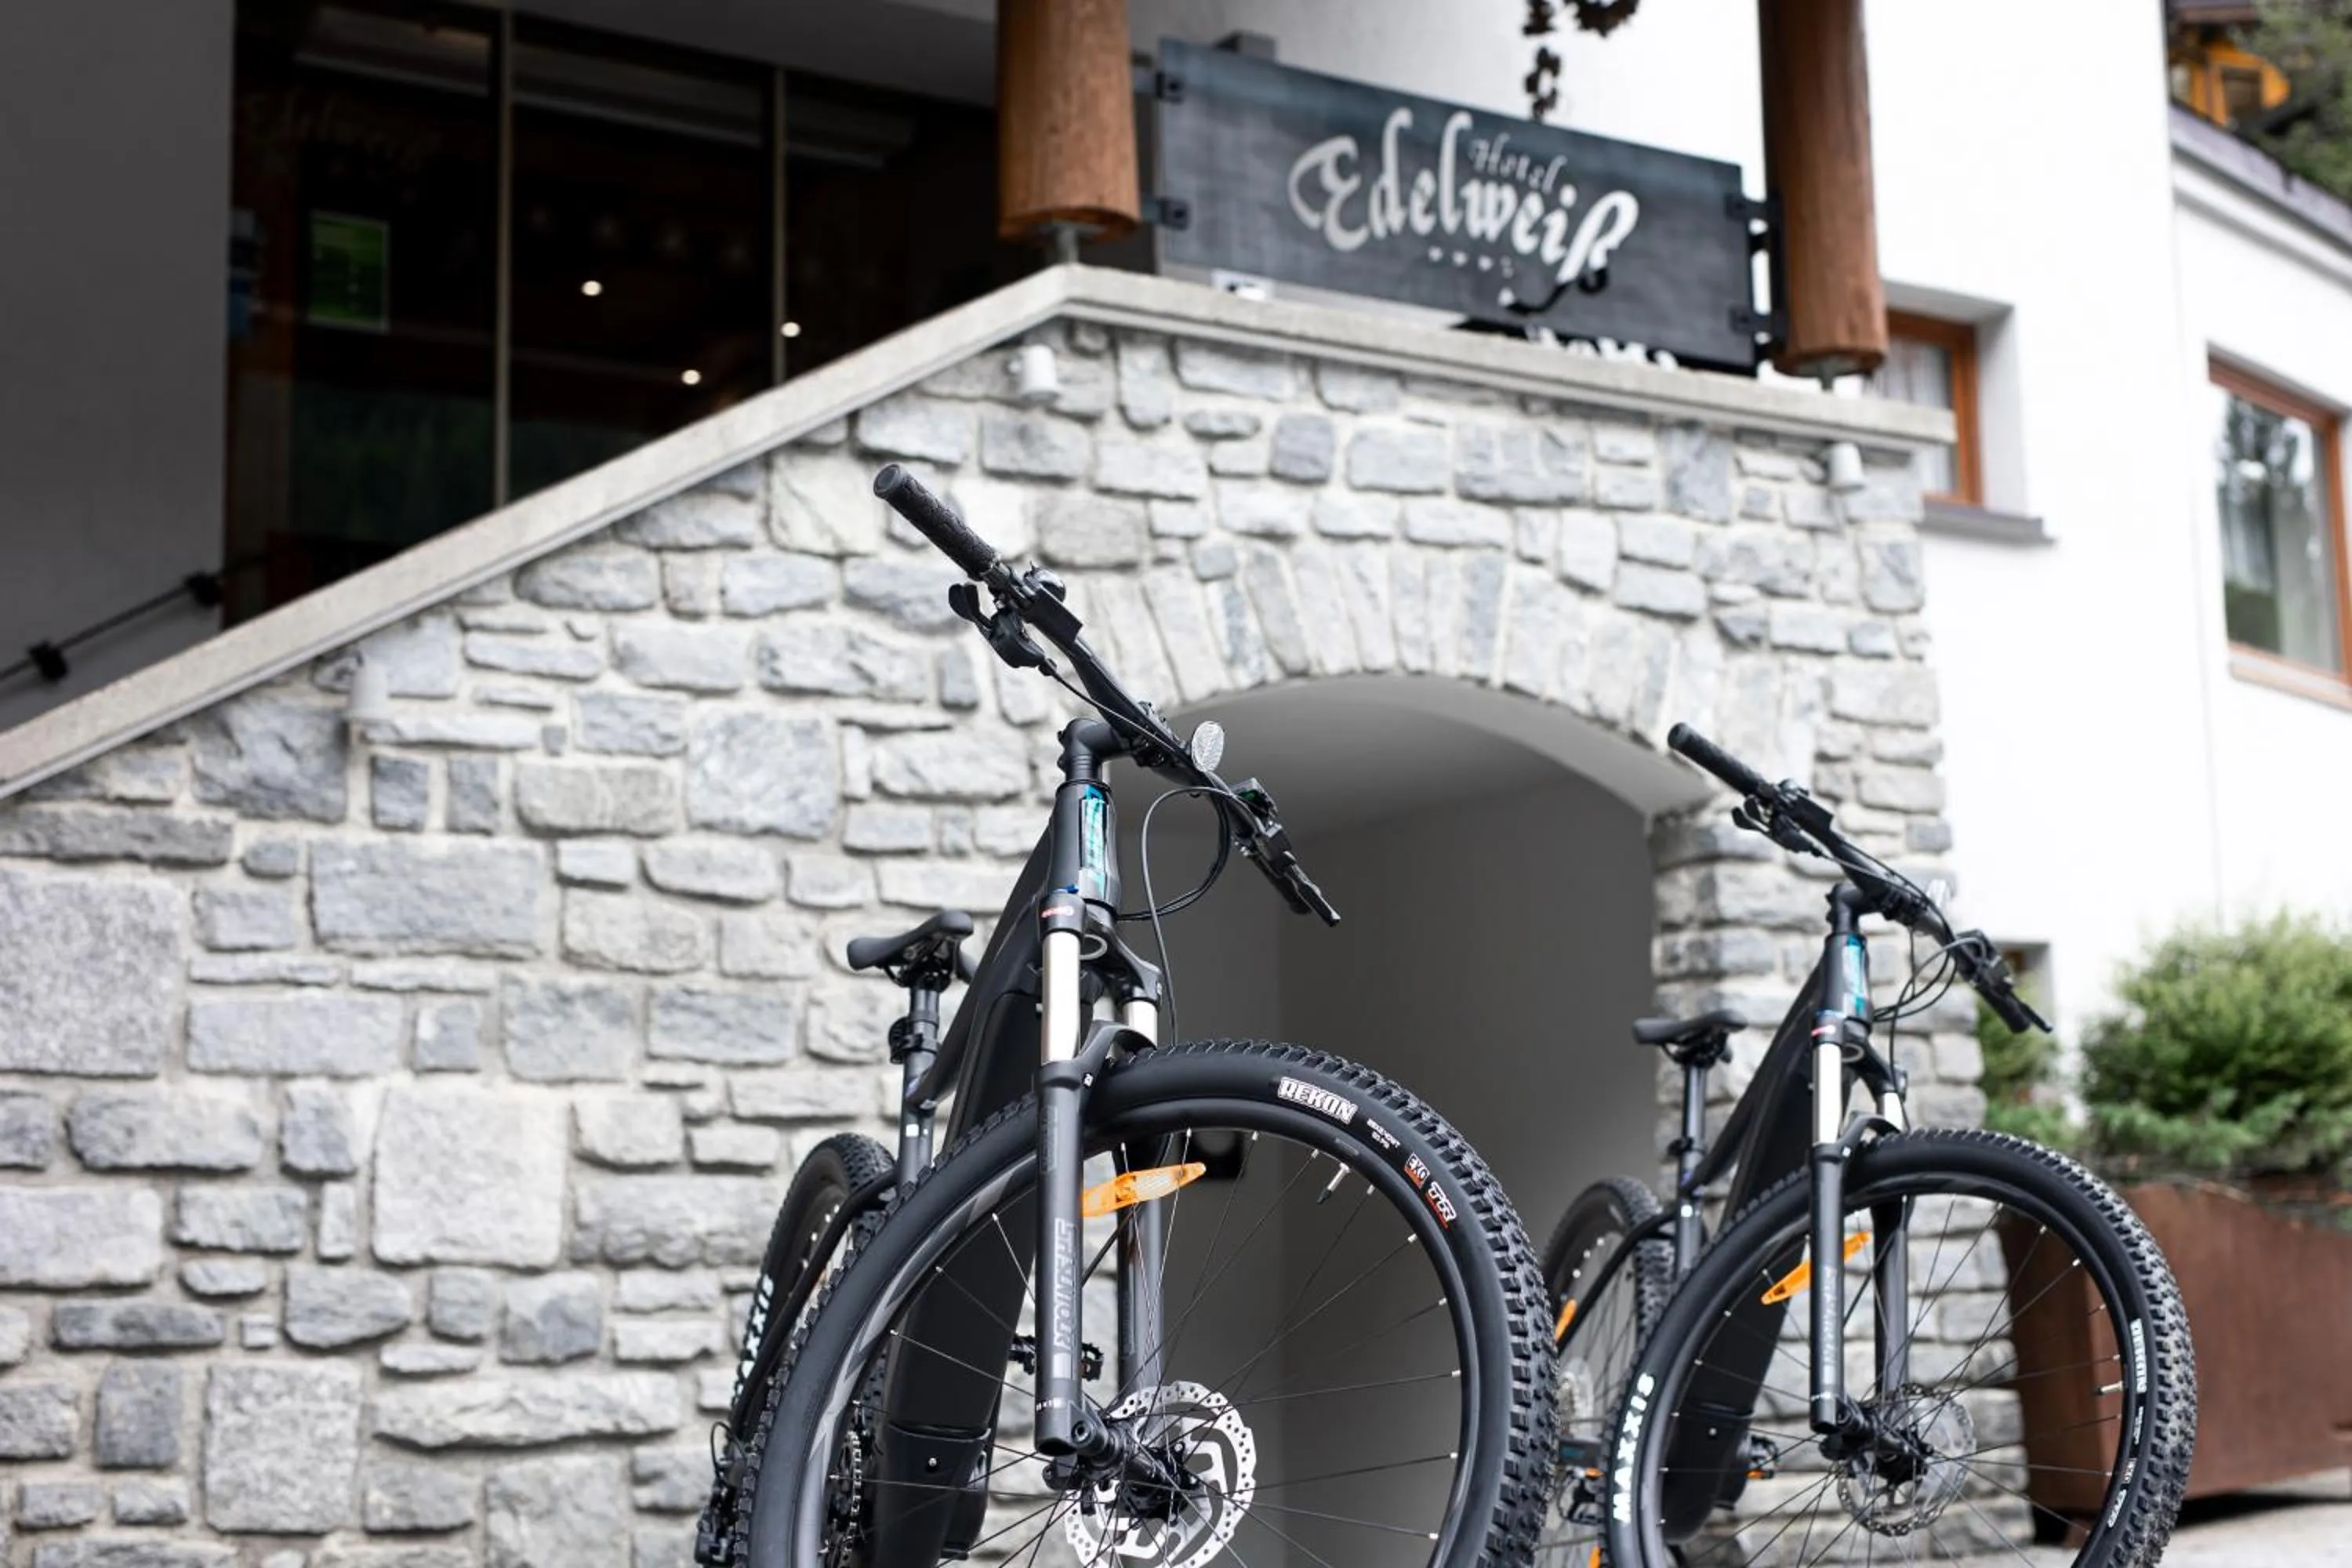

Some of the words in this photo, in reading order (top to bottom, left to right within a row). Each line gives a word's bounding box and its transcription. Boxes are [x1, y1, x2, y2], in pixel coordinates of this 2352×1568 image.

[1467, 132, 1568, 194] Hotel
[1277, 1076, 1358, 1124] REKON
[734, 1274, 775, 1406] AXXIS
[1613, 1373, 1654, 1524] MAXXIS
